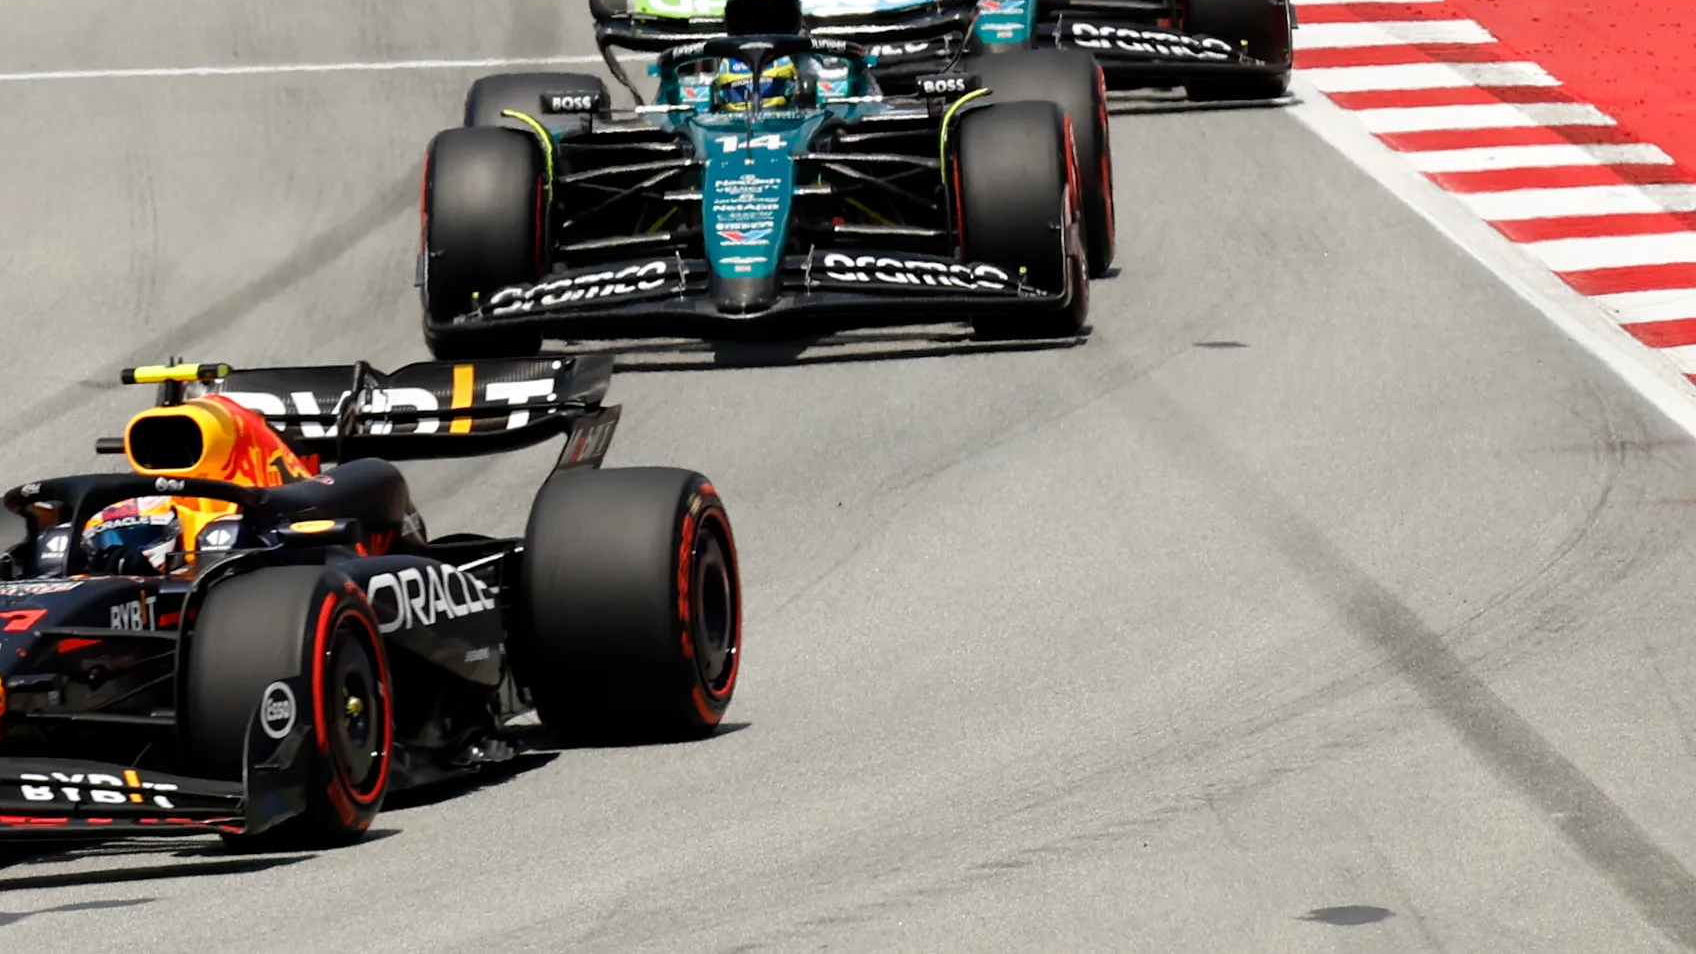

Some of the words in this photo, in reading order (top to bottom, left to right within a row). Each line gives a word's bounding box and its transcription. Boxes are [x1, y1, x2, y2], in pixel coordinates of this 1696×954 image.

[1071, 22, 1233, 61] aramco
[551, 95, 592, 111] BOSS
[923, 78, 966, 93] BOSS
[714, 133, 788, 154] 14
[490, 260, 668, 315] aramco
[823, 252, 1009, 290] aramco
[366, 562, 500, 634] ORACLE
